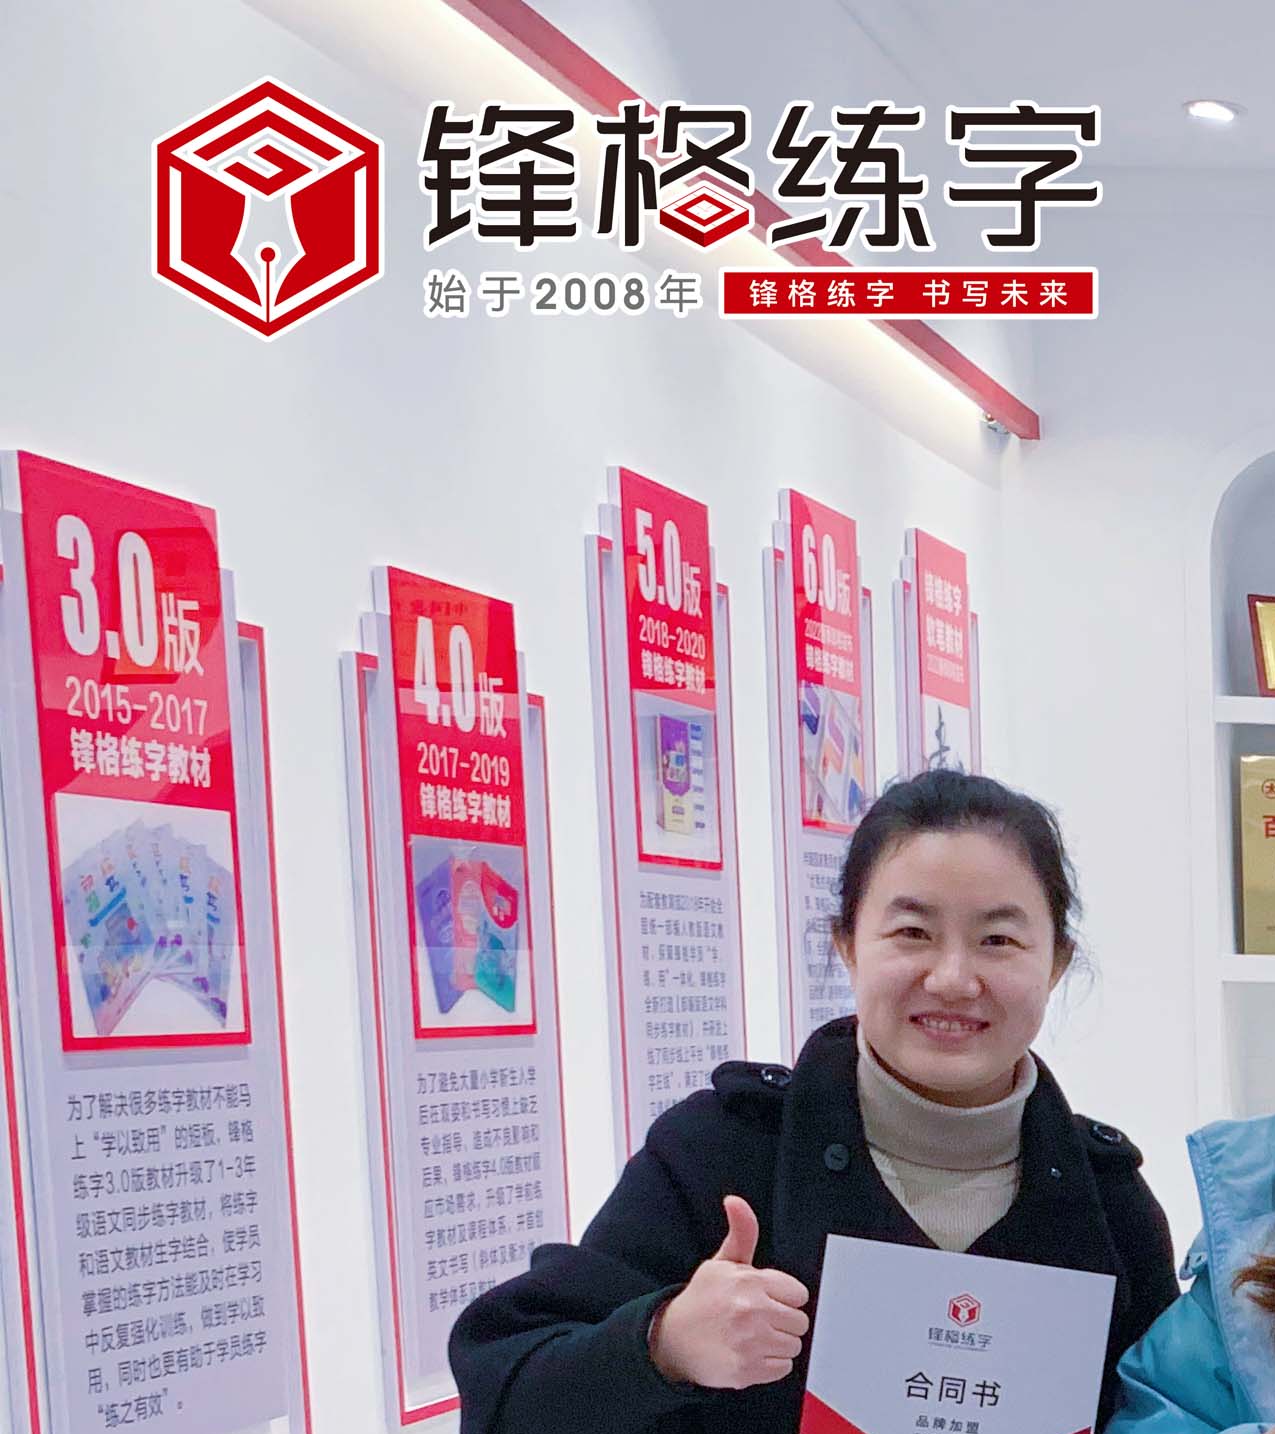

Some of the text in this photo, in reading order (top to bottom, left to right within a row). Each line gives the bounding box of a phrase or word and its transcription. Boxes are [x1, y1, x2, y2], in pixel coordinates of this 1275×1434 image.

[635, 508, 703, 620] 5.0版
[801, 524, 852, 619] 6.0版
[56, 514, 205, 676] 3.0版
[639, 613, 706, 661] 2018-2020
[66, 676, 208, 736] 2015-2017
[414, 615, 507, 738] 4.0版
[70, 727, 211, 788] 锋格练字教材
[417, 741, 511, 787] 2017-2019
[419, 781, 512, 828] 锋格练字教材
[928, 1326, 993, 1349] 锋格练字
[904, 1371, 1002, 1409] 合同书
